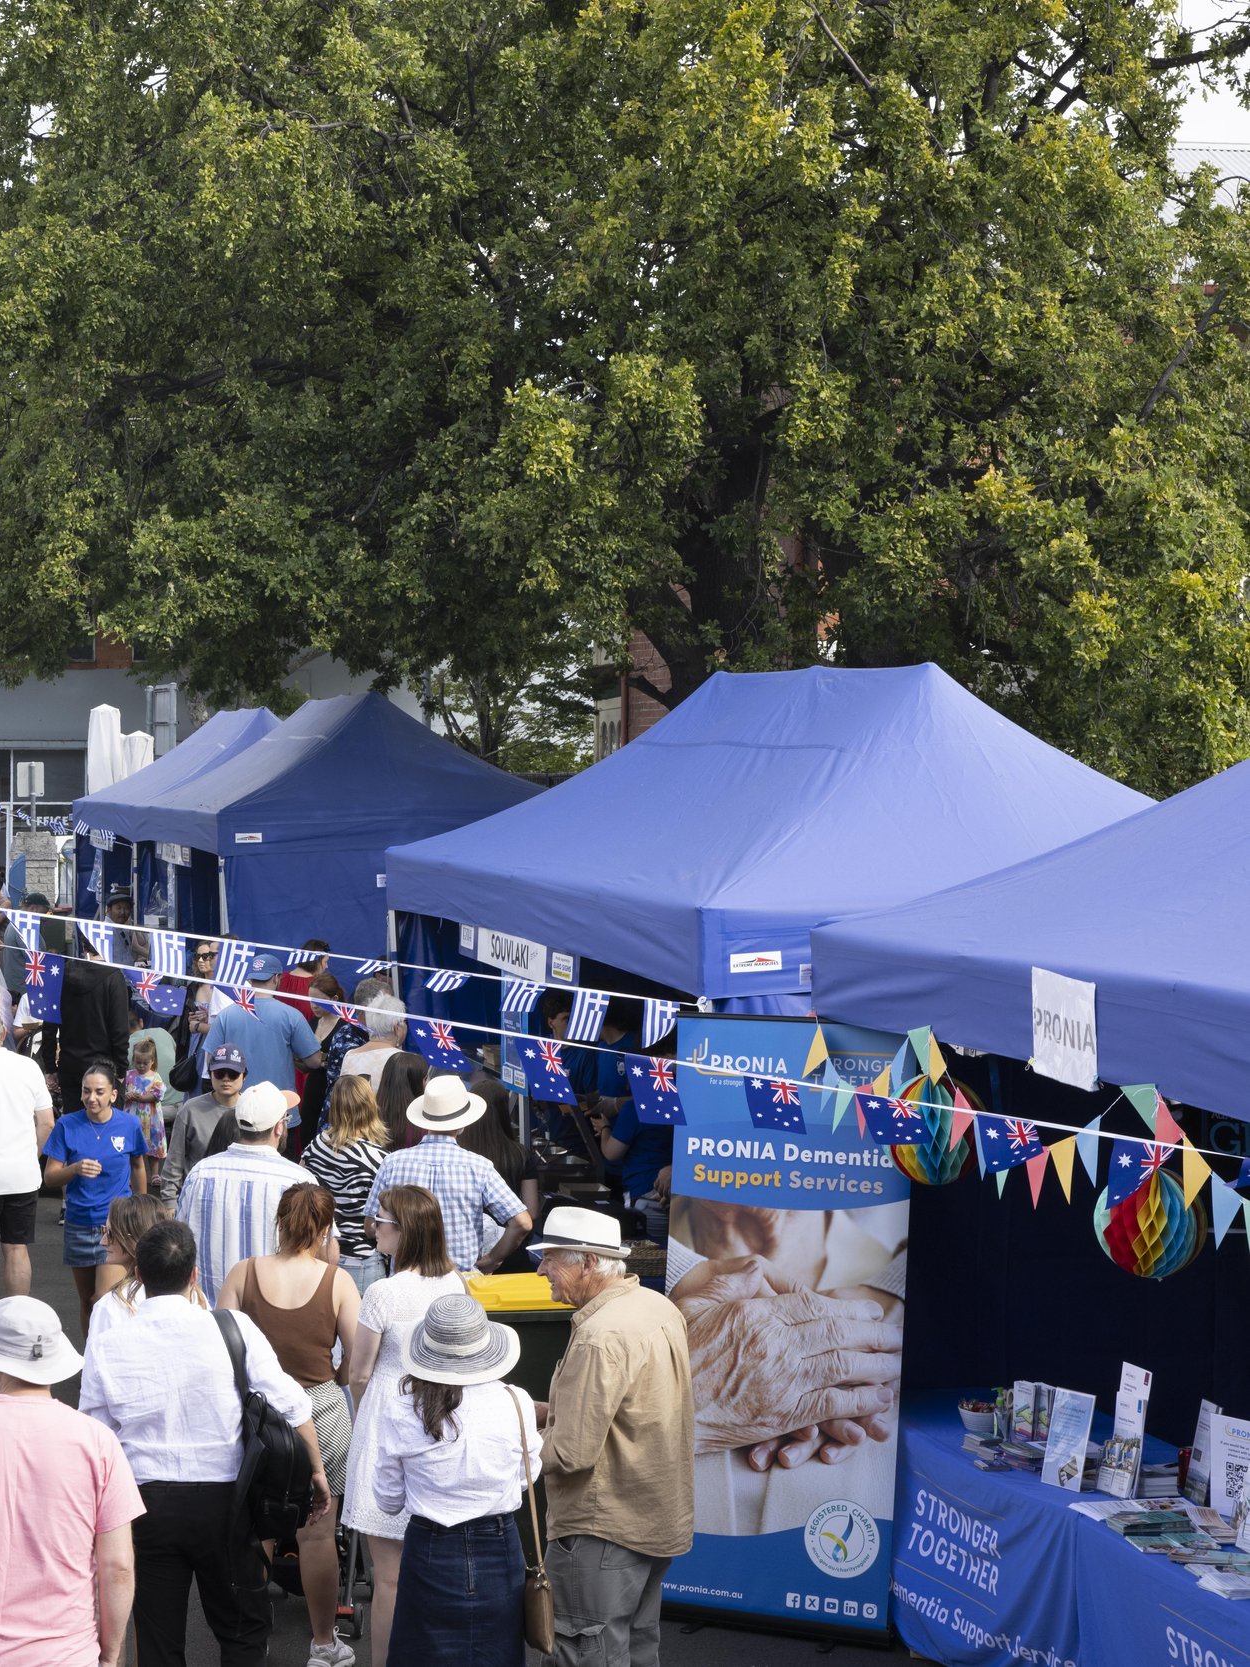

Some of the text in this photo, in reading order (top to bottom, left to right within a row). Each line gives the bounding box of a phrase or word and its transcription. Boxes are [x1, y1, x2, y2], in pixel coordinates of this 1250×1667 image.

[491, 933, 529, 970] SOUVLAKI
[1033, 1007, 1096, 1055] PRONIA
[709, 1077, 718, 1085] For
[723, 1079, 744, 1088] stronger
[710, 1054, 788, 1074] PRONIA
[687, 1137, 893, 1168] PRONIA Dementia
[693, 1164, 884, 1195] Support Services
[809, 1504, 875, 1544] REGISTERED CHARITY
[915, 1489, 1002, 1560] STRONGER
[907, 1522, 999, 1596] TOGETHER
[951, 1608, 1011, 1653] Support
[1012, 1635, 1077, 1667] Service
